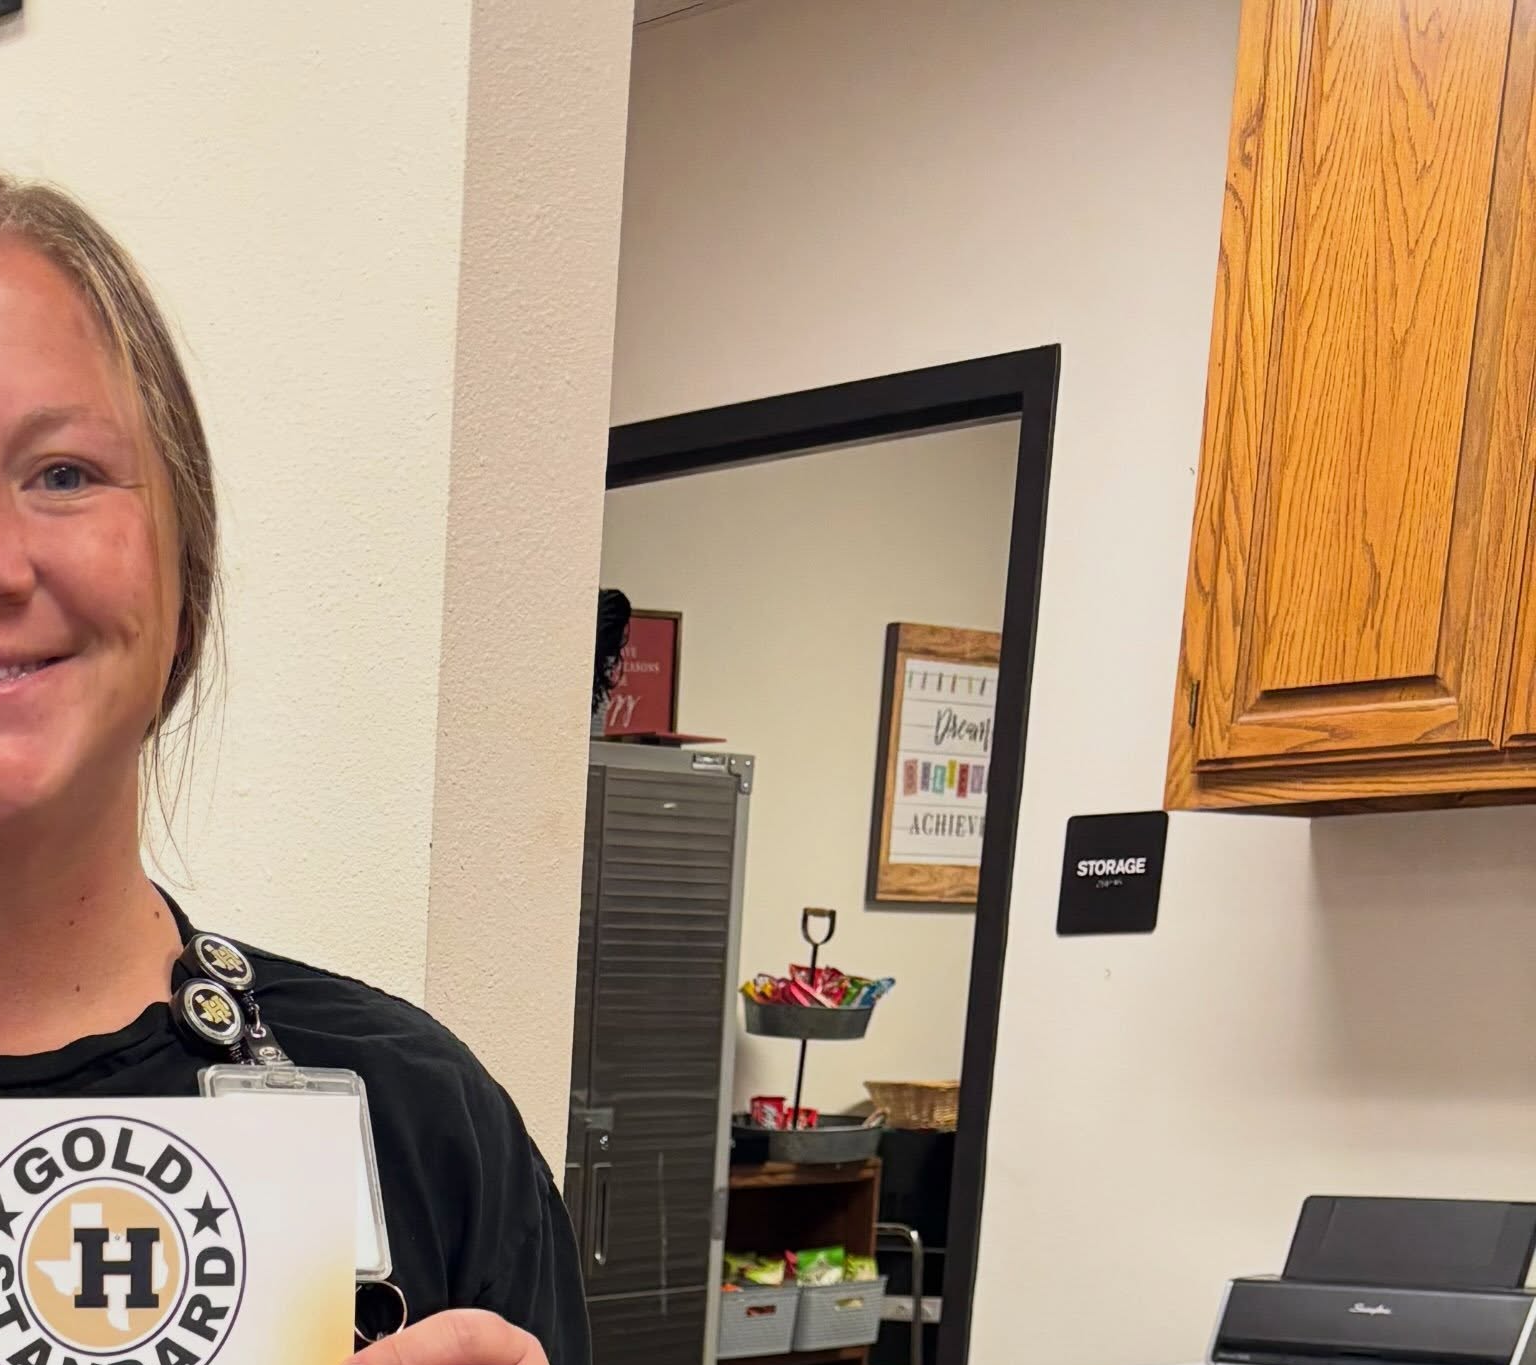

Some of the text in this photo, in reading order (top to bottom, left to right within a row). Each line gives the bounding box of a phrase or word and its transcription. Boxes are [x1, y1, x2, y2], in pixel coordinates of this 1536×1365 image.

[1076, 857, 1147, 877] STORAGE
[13, 1126, 193, 1195] GOLD
[73, 1227, 161, 1309] H
